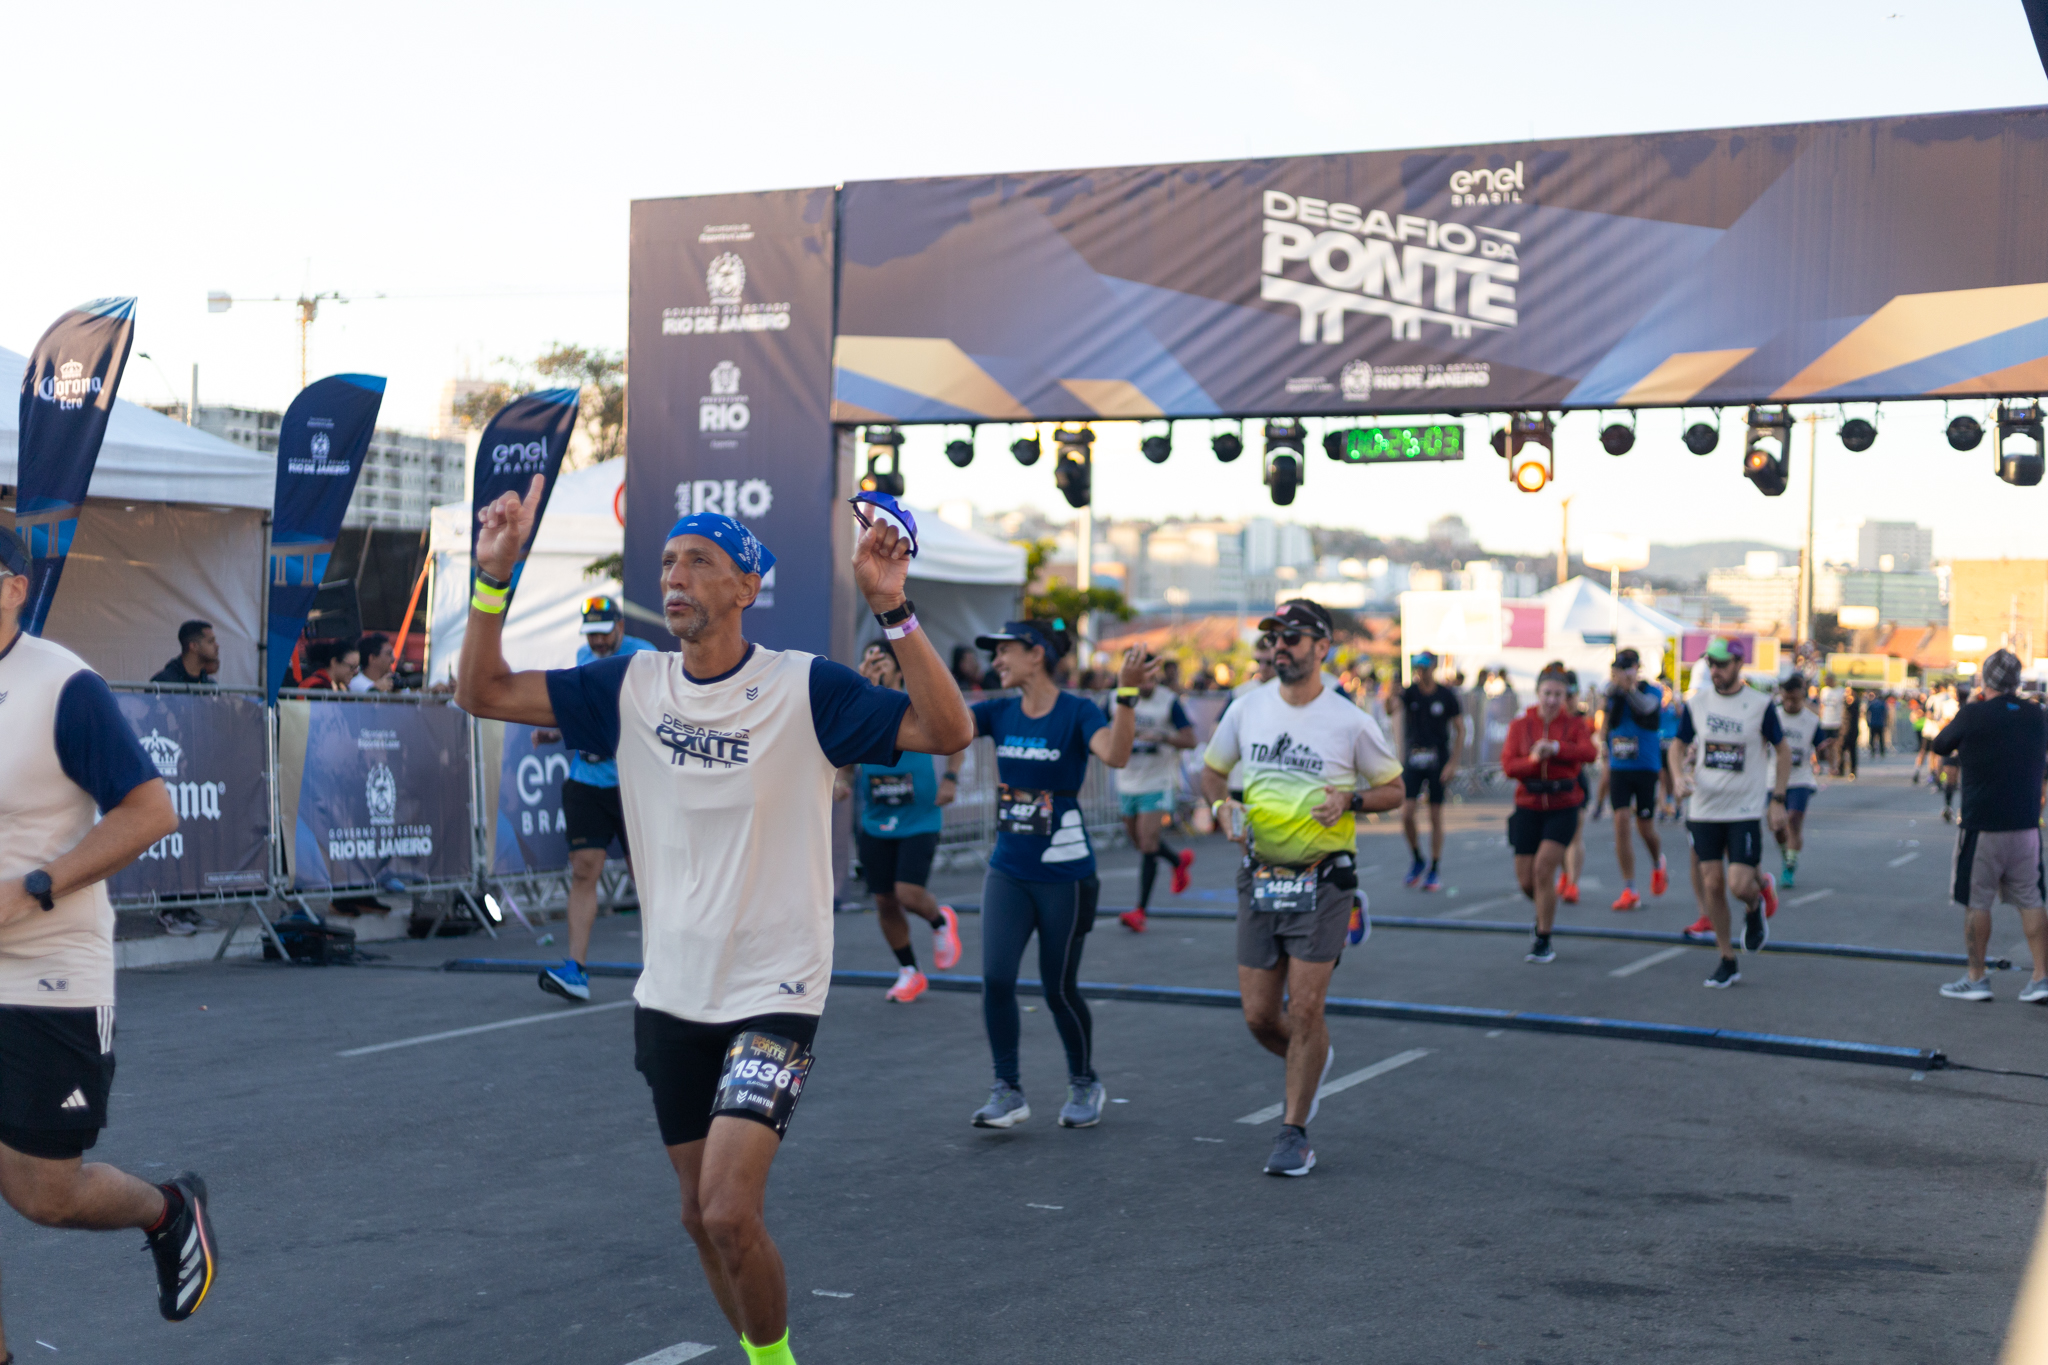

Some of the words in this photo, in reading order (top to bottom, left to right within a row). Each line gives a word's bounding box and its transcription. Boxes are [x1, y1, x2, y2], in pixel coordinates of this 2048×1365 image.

[1449, 160, 1524, 194] enel
[1451, 191, 1523, 208] BRASIL
[1263, 189, 1477, 255] DESAFIO
[1480, 239, 1519, 261] DA
[1262, 218, 1520, 327] PONTE
[662, 317, 694, 336] RIO
[694, 316, 719, 334] DE
[718, 312, 791, 333] JANEIRO
[38, 375, 102, 403] Corona
[1372, 374, 1401, 390] RIO
[1401, 373, 1424, 389] DE
[1424, 371, 1490, 389] JANEIRO
[699, 403, 751, 432] RIO
[491, 435, 548, 464] enel
[692, 478, 774, 518] RIO
[656, 723, 750, 763] PONTE
[516, 753, 571, 806] en
[521, 807, 567, 836] BRA
[329, 840, 356, 860] RIO
[357, 839, 377, 860] DE
[377, 836, 433, 858] JANEIRO
[1266, 880, 1304, 895] 1484
[751, 1038, 786, 1062] PONTE
[734, 1059, 792, 1088] 1536
[747, 1093, 775, 1109] ARMYBR
